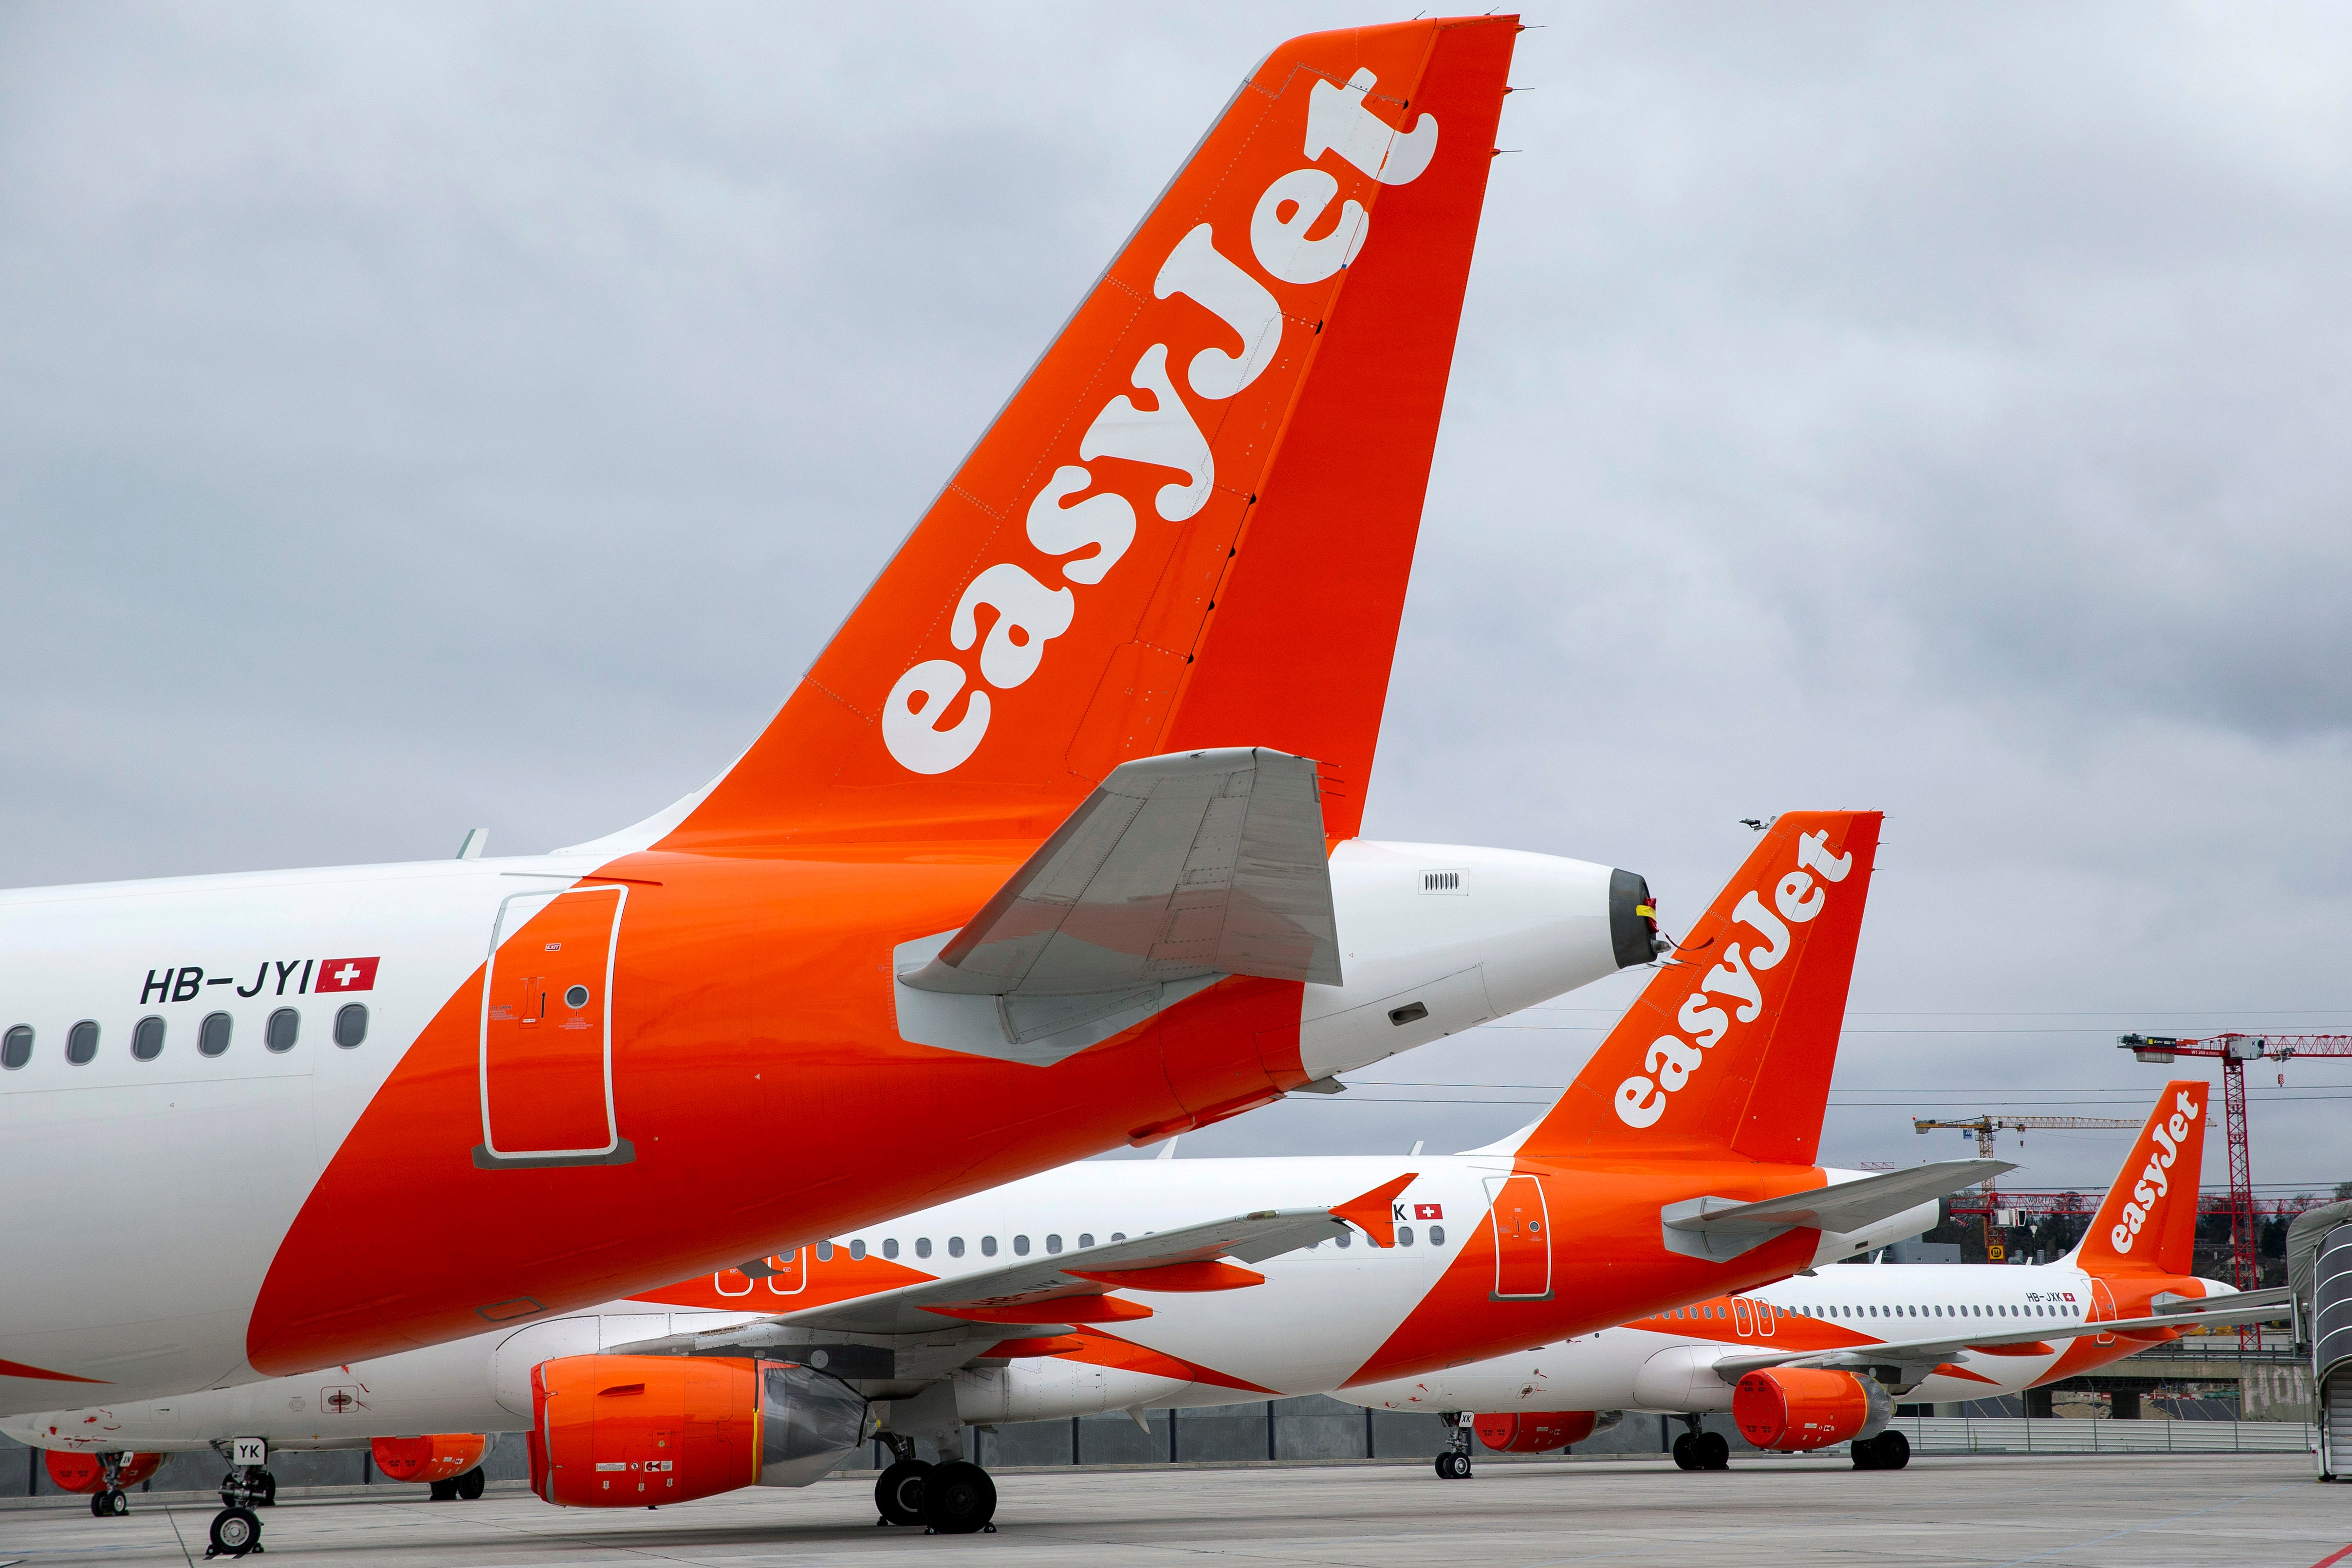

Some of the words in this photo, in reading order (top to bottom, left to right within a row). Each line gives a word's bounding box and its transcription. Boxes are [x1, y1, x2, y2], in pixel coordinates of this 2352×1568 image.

[882, 66, 1438, 775] easyJet
[140, 959, 314, 1005] HB-JYI
[1614, 829, 1852, 1128] easyJet
[2111, 1089, 2199, 1254] easyJet
[2026, 1292, 2064, 1302] HB-JXK
[240, 1445, 260, 1458] YK
